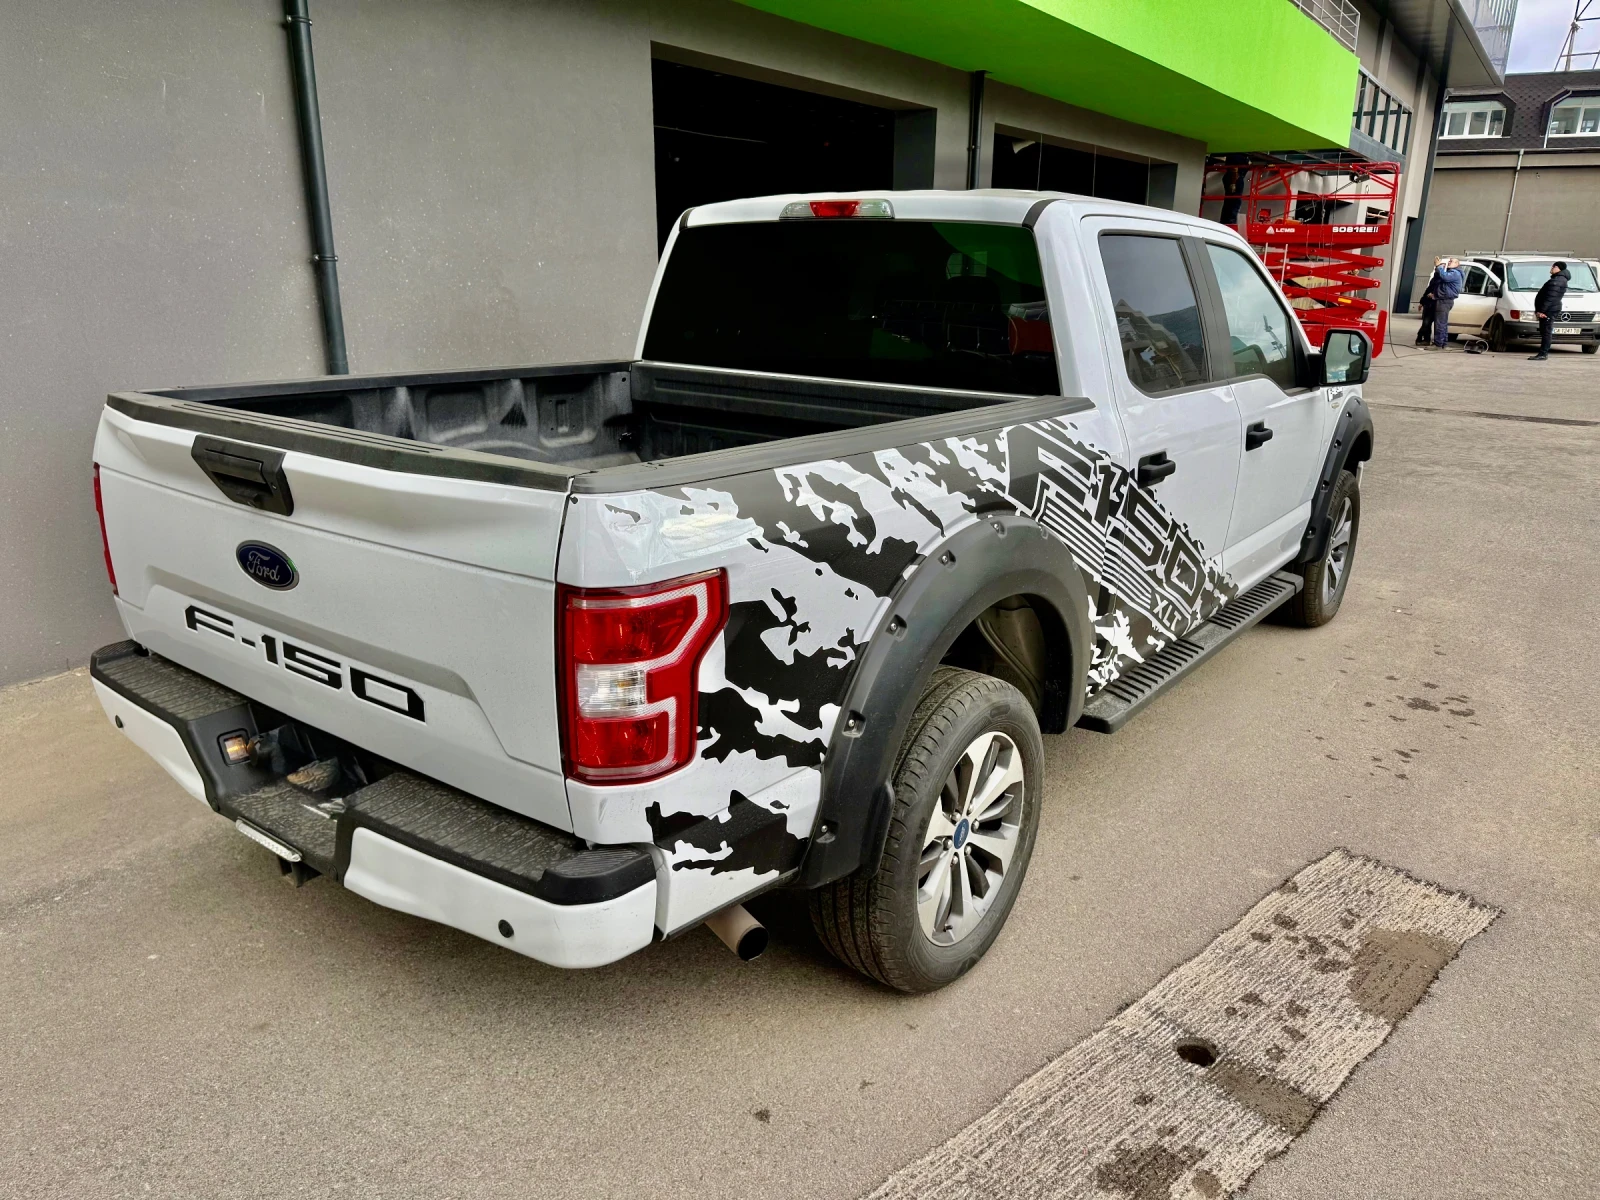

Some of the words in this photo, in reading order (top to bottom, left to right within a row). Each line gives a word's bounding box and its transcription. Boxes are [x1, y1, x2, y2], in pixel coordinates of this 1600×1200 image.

[246, 551, 281, 581] Ford
[1153, 593, 1182, 631] XLT
[184, 605, 426, 723] F-150
